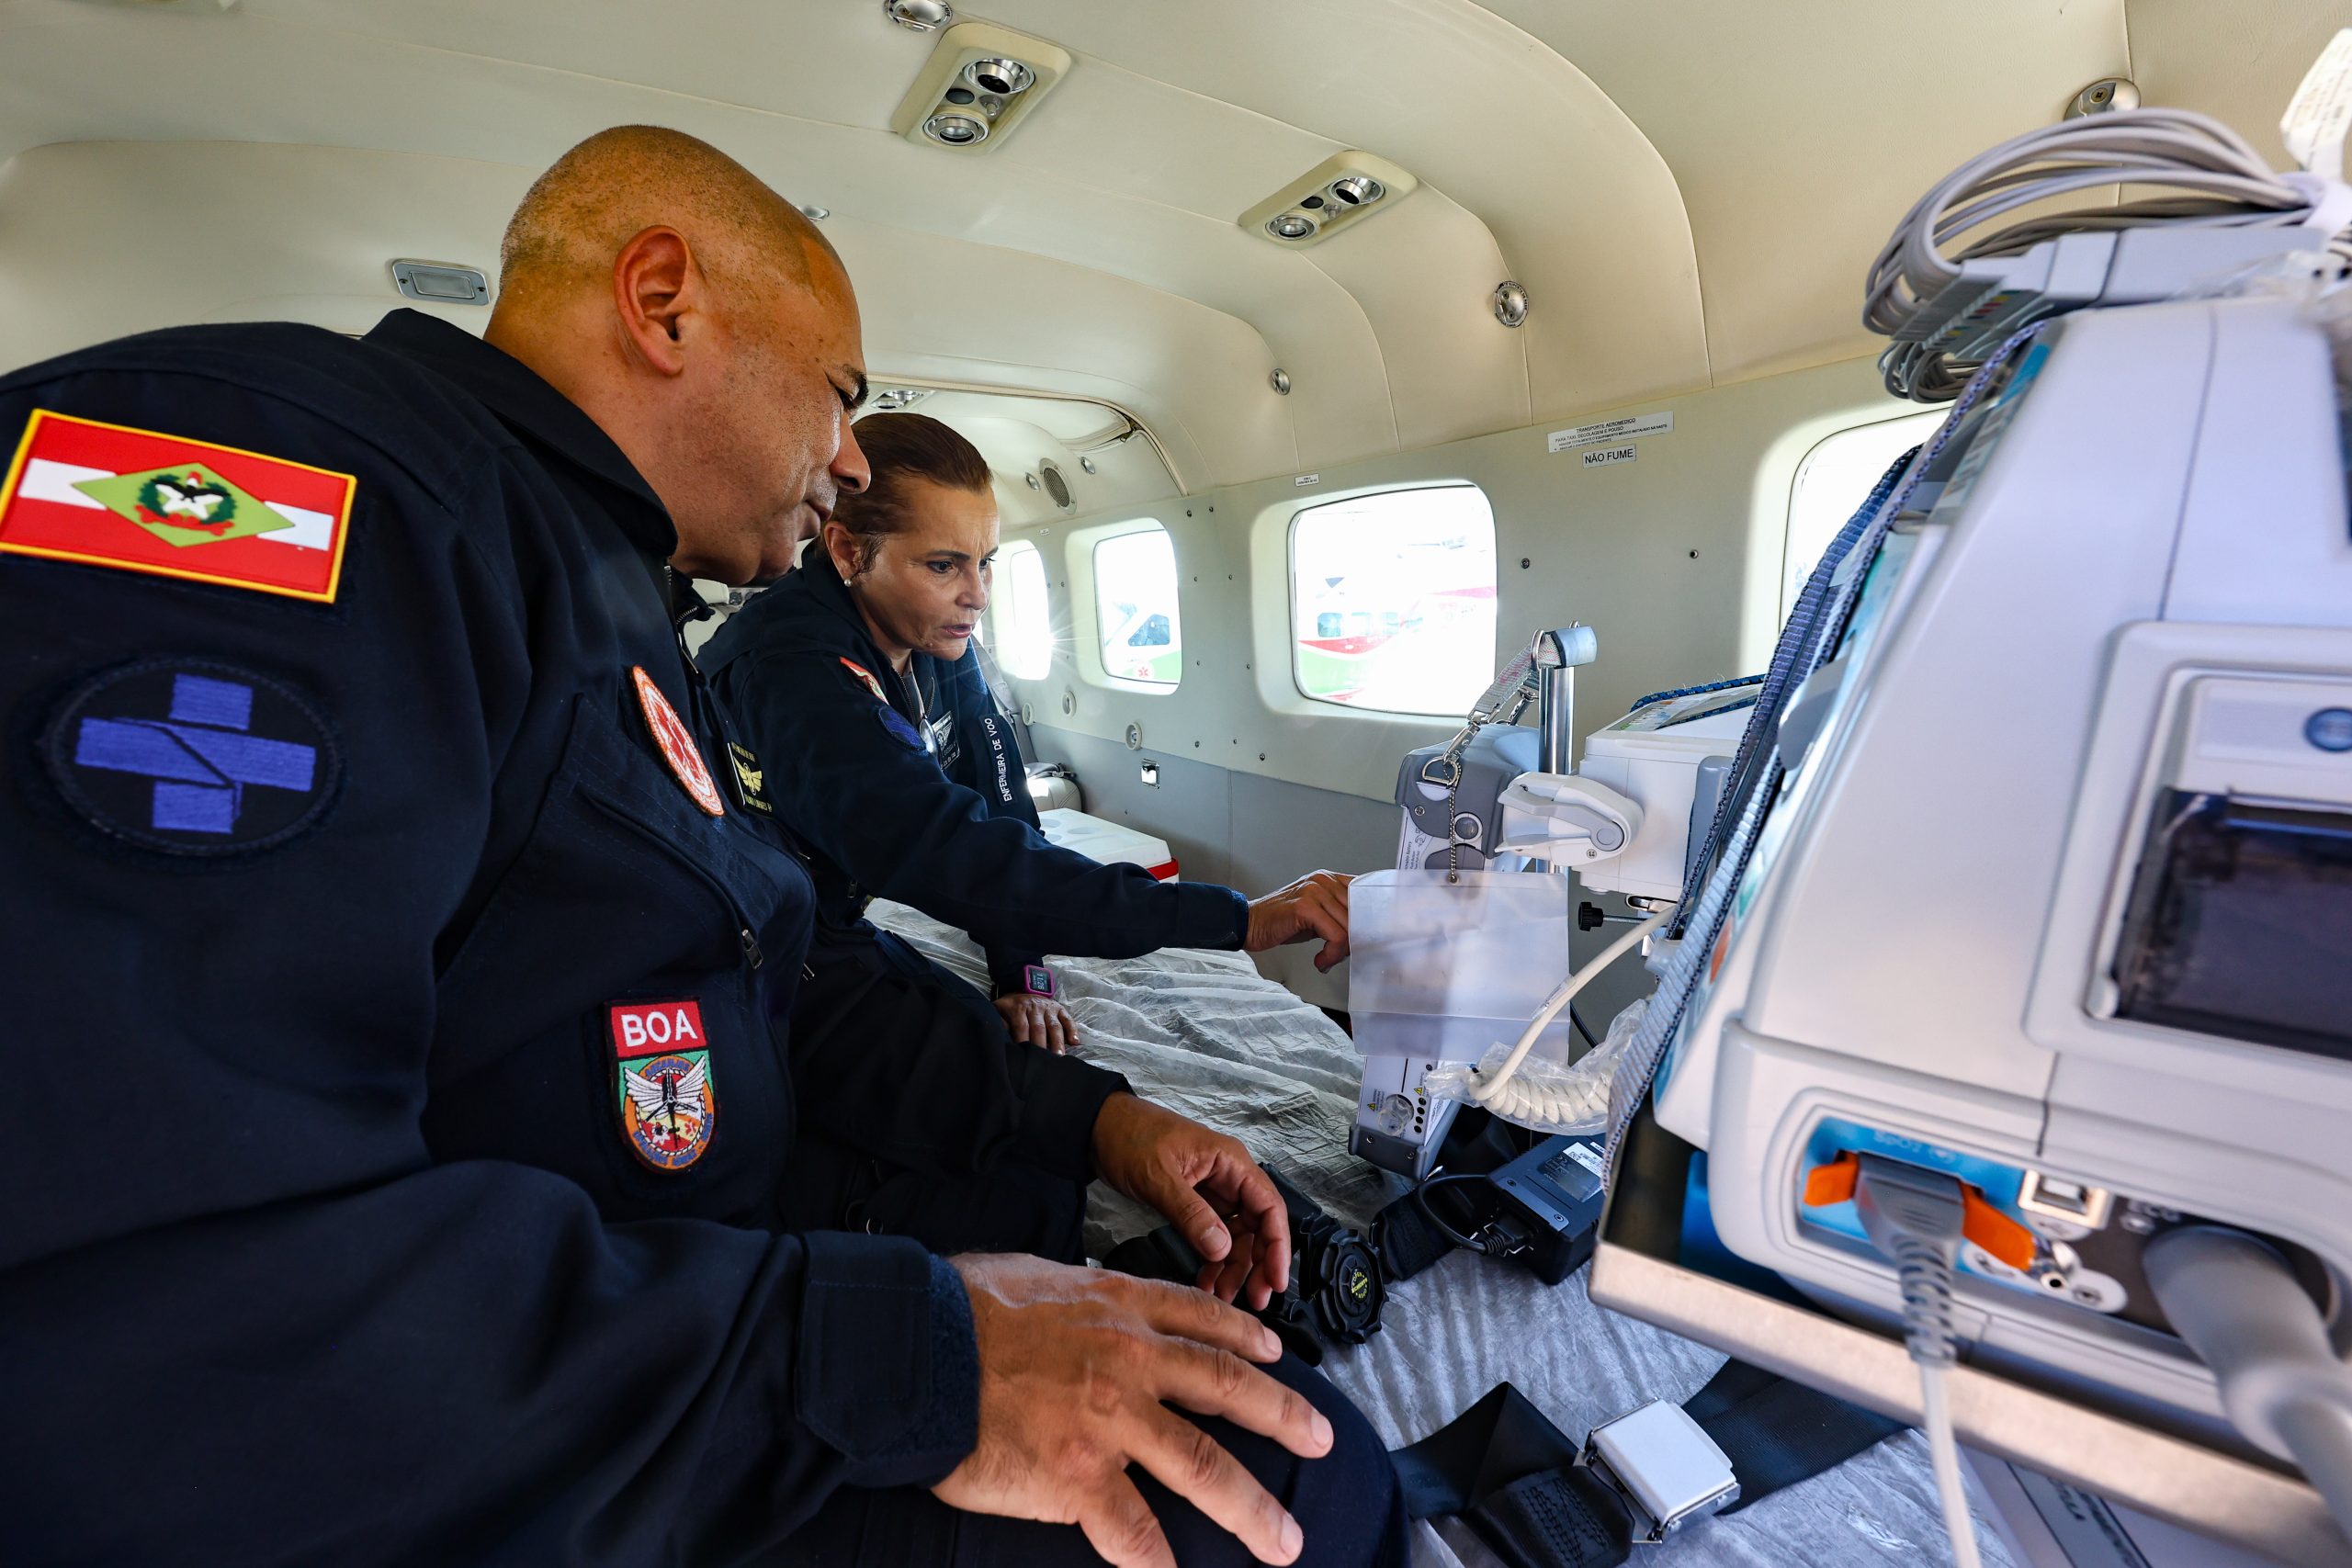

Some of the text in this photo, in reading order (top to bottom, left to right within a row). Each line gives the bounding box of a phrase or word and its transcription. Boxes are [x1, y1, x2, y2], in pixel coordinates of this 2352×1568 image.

[1577, 423, 1605, 434] TRANSPORTE
[1585, 448, 1634, 464] NÃO FUME
[984, 717, 1012, 802] ENFERMEIRA DE VOO
[621, 1009, 697, 1047] BOA
